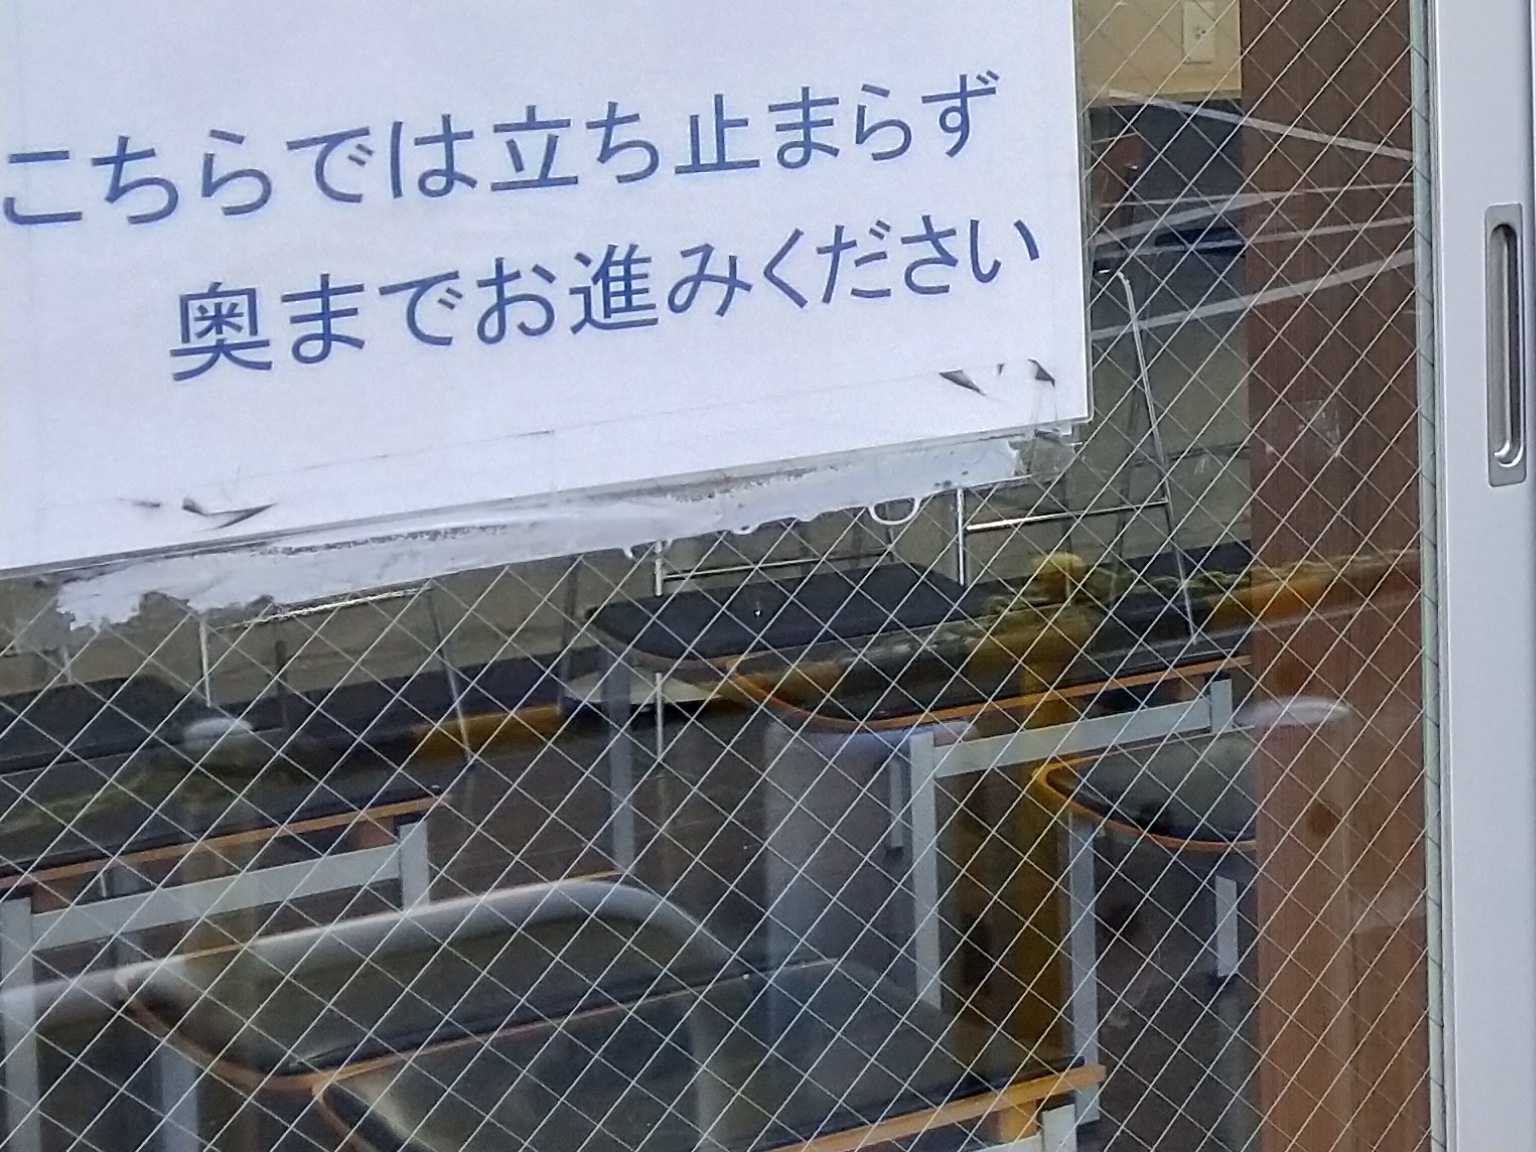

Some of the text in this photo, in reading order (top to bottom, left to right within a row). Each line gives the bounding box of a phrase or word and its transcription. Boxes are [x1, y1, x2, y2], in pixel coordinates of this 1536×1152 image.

[2, 70, 1000, 228] こちらでは立ち止まらず
[169, 214, 1043, 383] 奥までお進みください
